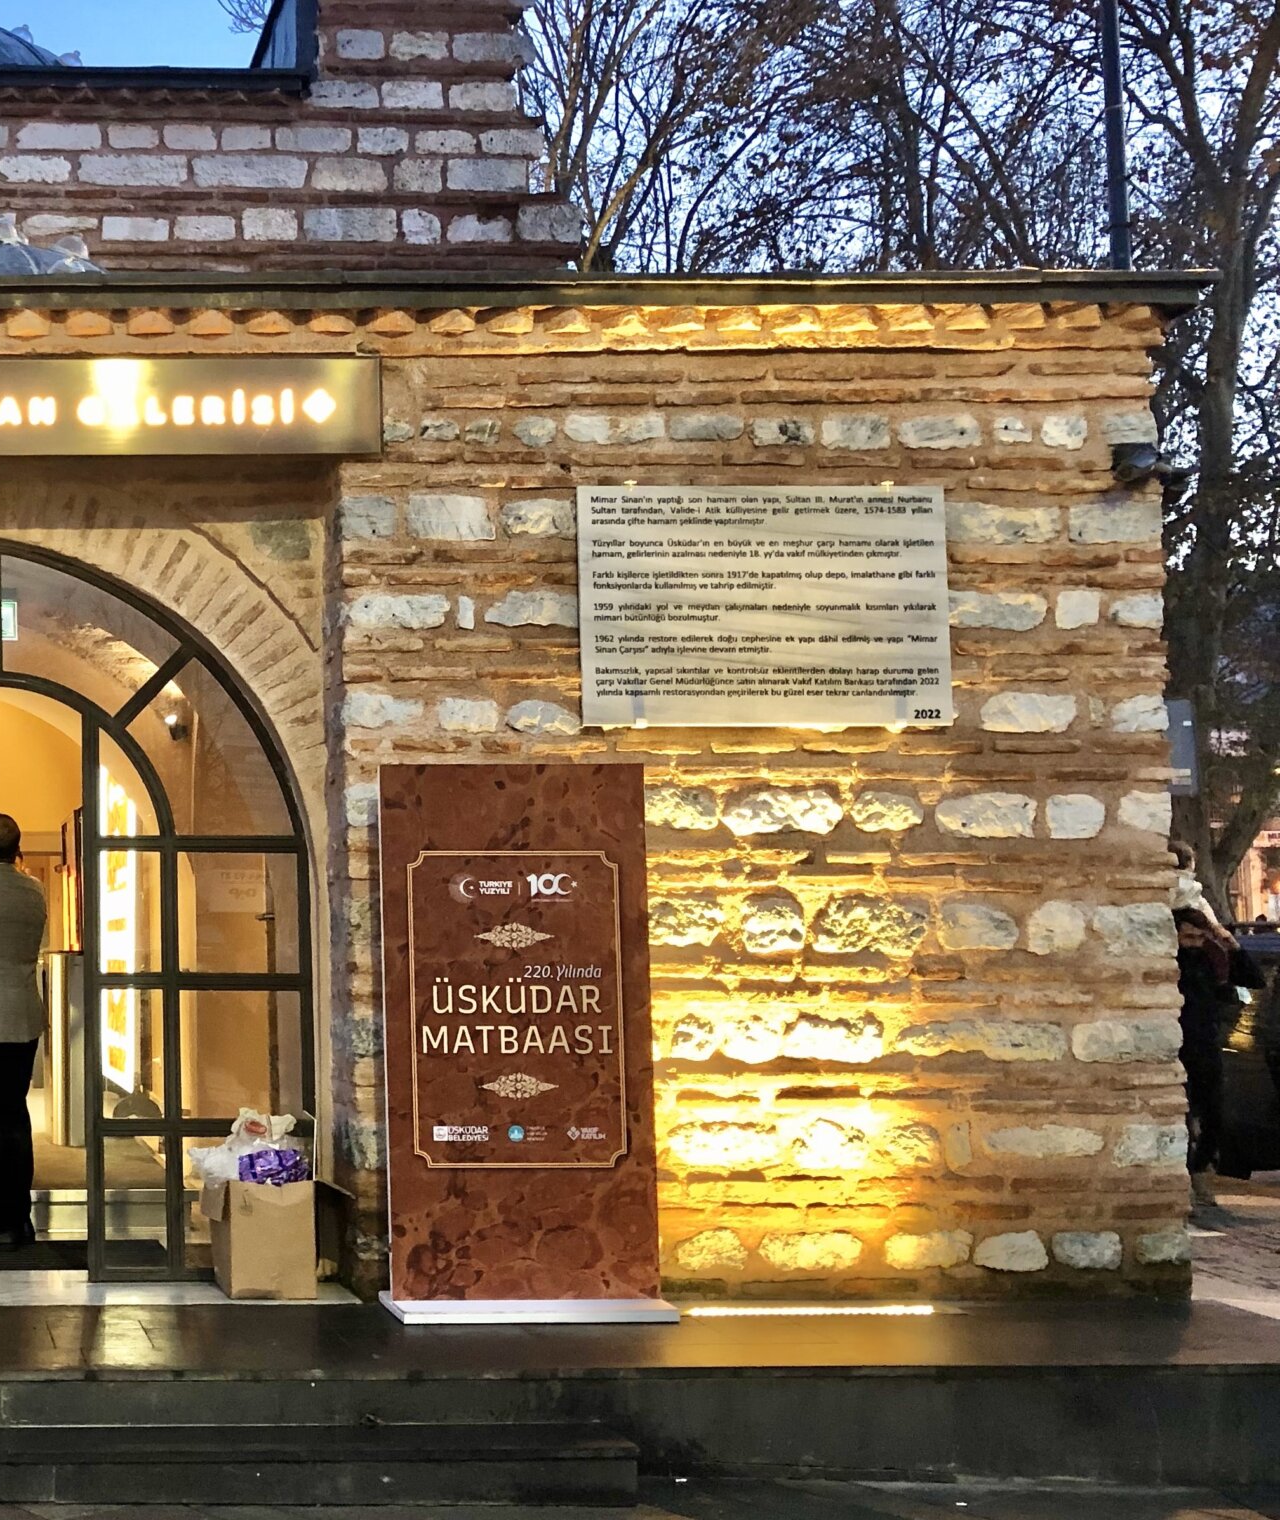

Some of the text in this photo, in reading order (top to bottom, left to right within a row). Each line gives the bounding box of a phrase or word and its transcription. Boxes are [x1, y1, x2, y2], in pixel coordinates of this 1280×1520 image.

[524, 964, 602, 981] 220. Yılında
[432, 977, 602, 1015] ÜSKÜDAR
[422, 1025, 613, 1055] MATBAASI
